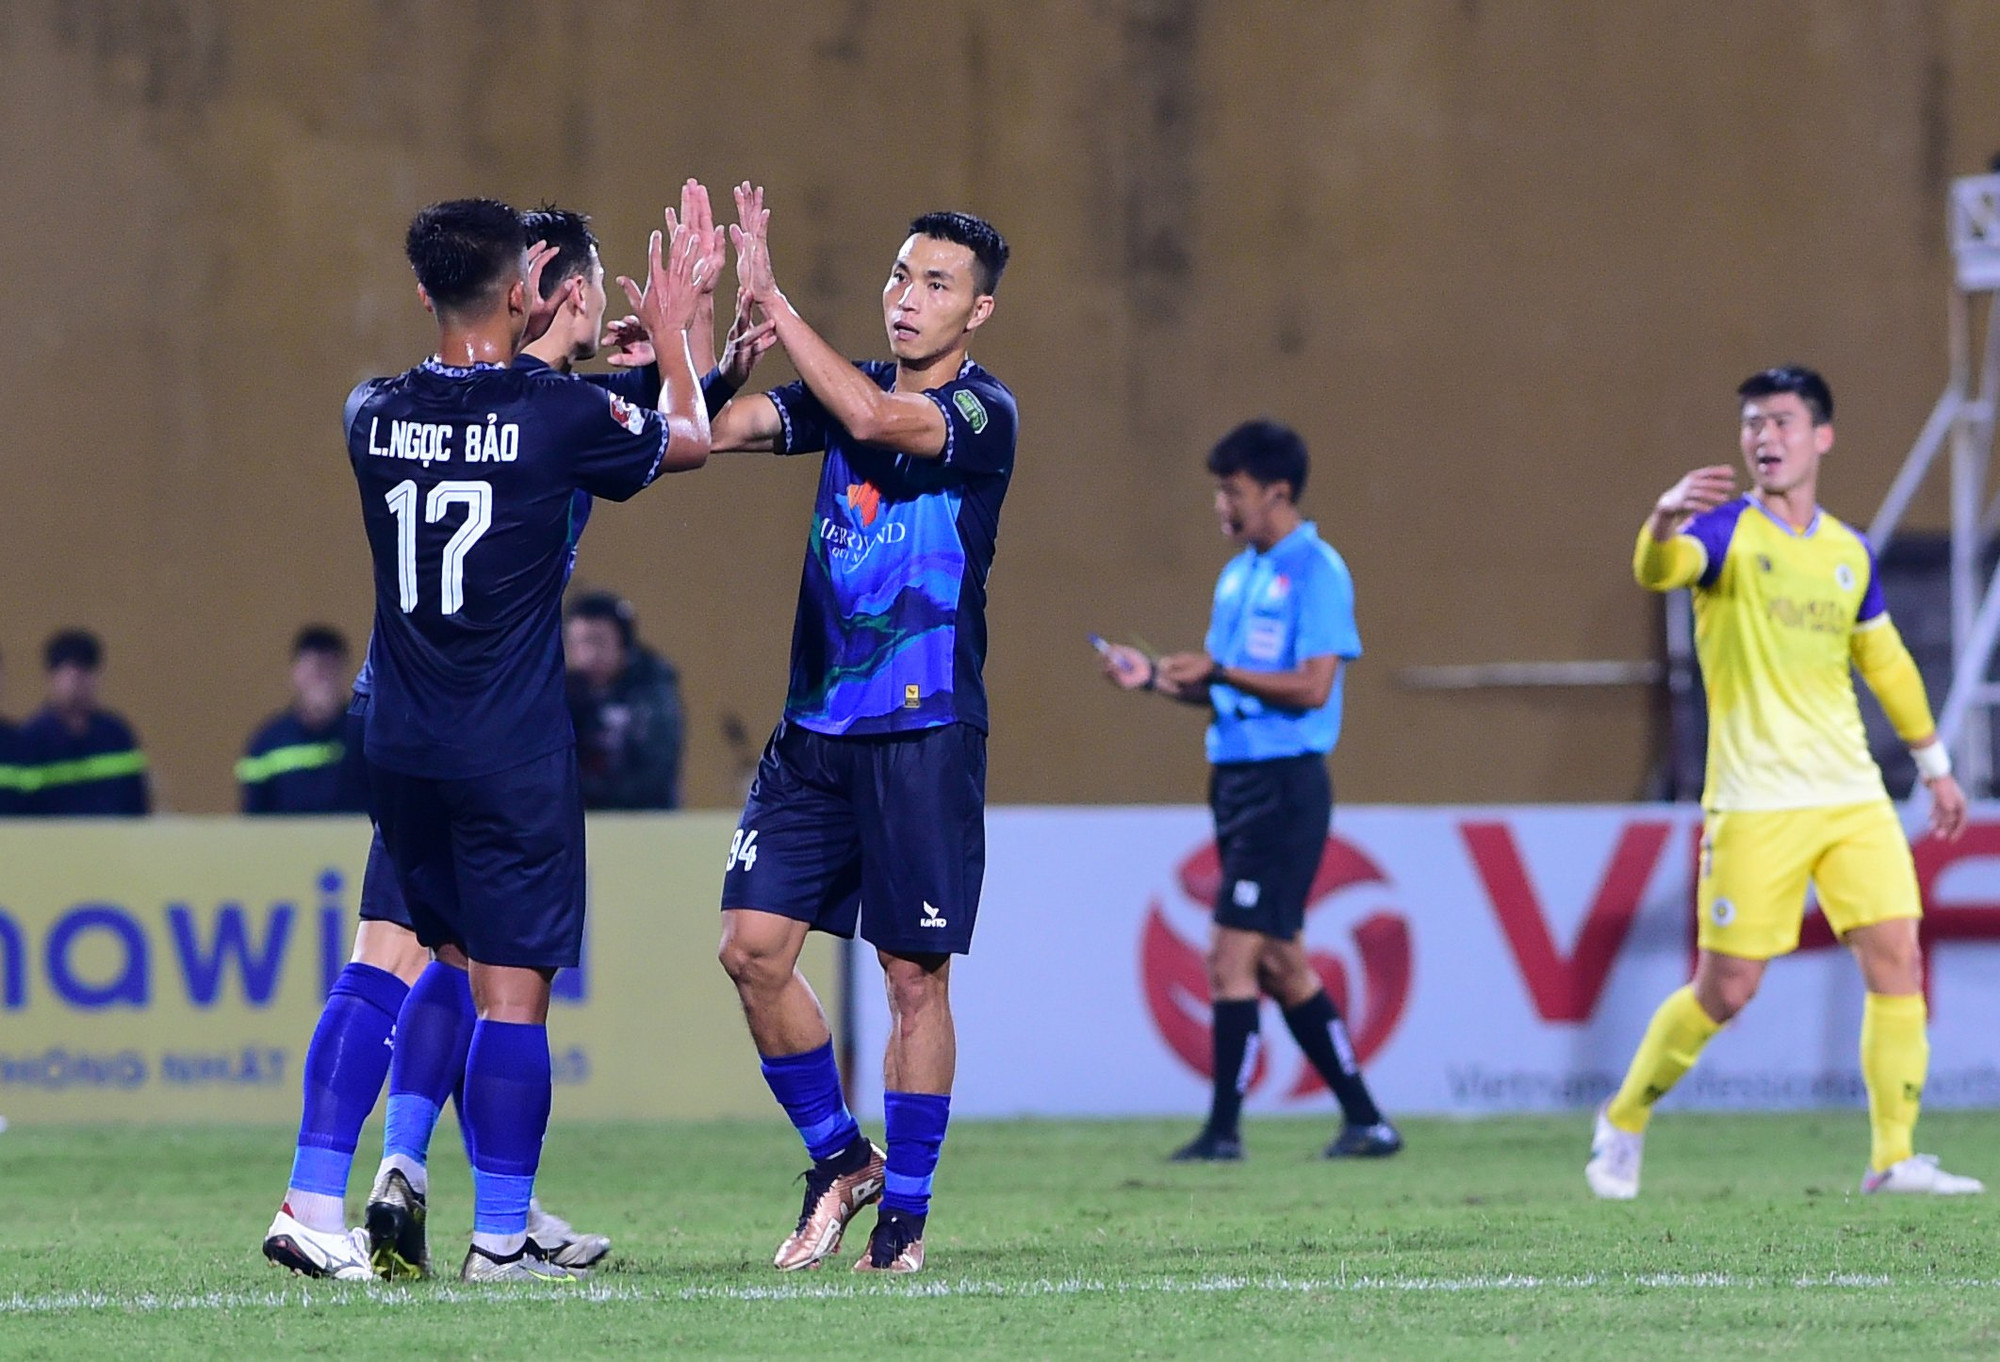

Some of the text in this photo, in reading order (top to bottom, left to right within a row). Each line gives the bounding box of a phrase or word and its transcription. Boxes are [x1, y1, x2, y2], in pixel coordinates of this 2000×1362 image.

[369, 412, 519, 468] L.NGỌC BẢO
[384, 479, 493, 615] 17
[726, 829, 759, 871] 94
